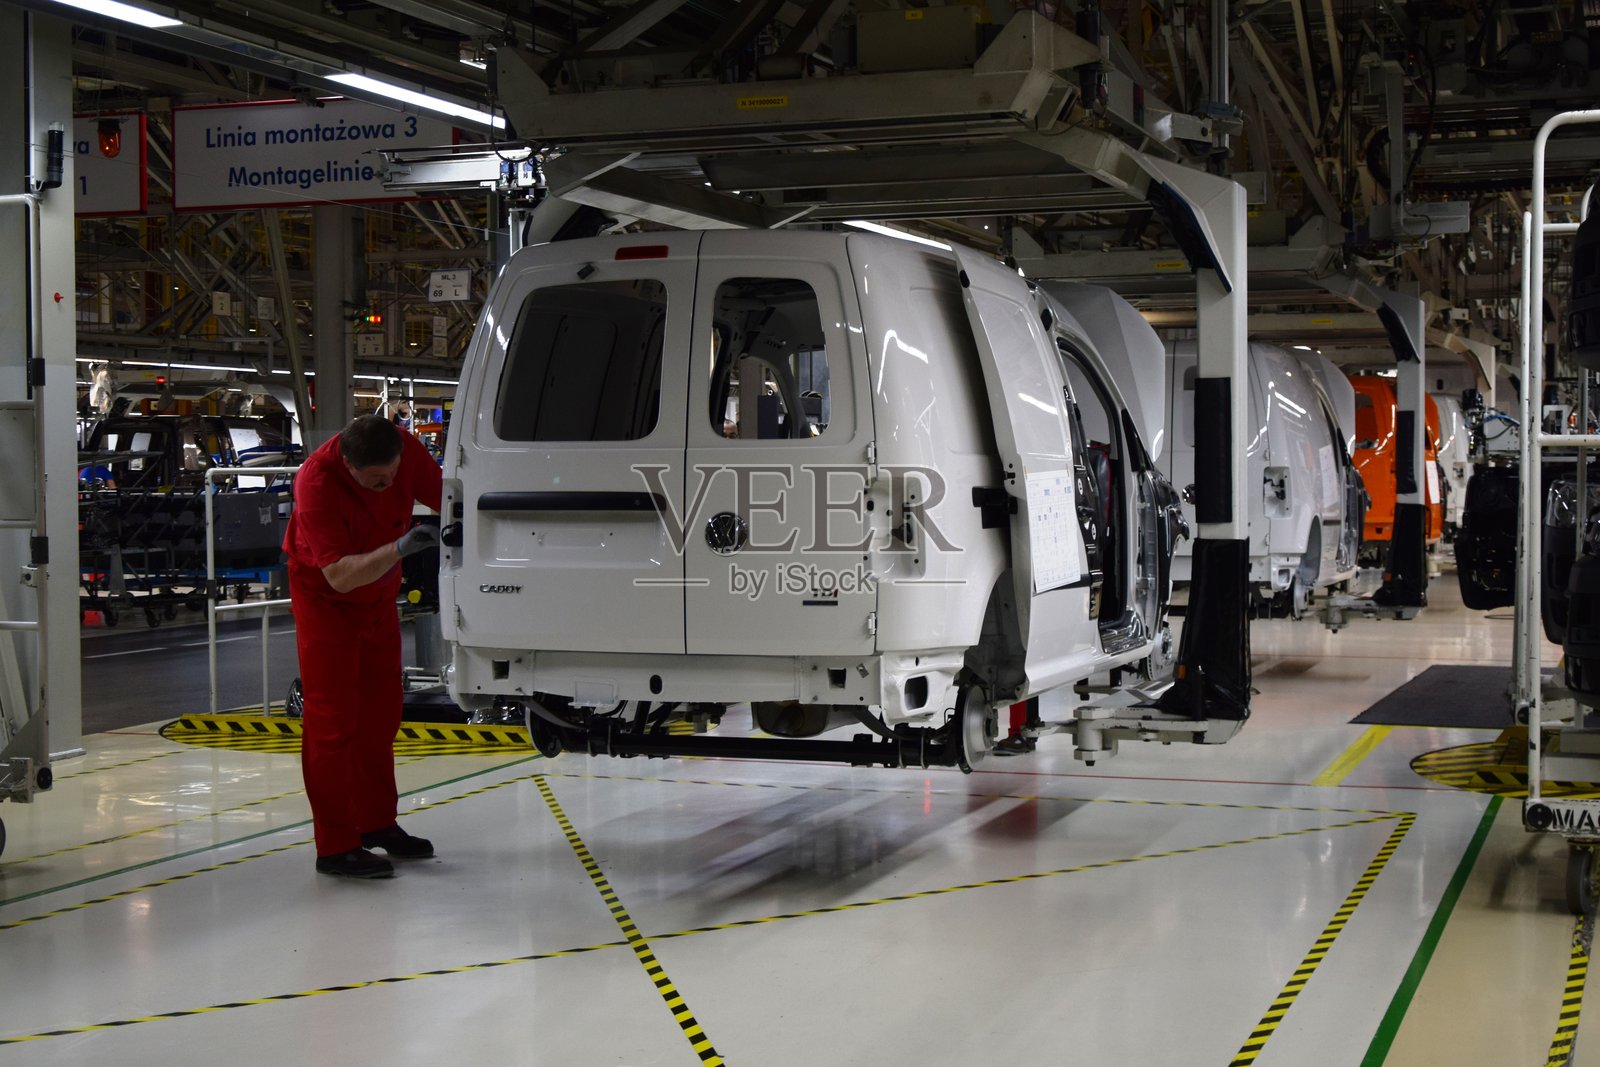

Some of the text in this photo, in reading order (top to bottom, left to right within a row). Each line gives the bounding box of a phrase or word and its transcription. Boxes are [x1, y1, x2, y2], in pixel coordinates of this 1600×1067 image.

[205, 116, 418, 148] Linia montażowa 3
[228, 159, 374, 189] Montagelinie
[79, 175, 87, 196] 1
[433, 289, 460, 297] 69 L
[480, 583, 523, 595] CADDY
[1552, 808, 1600, 831] MA
